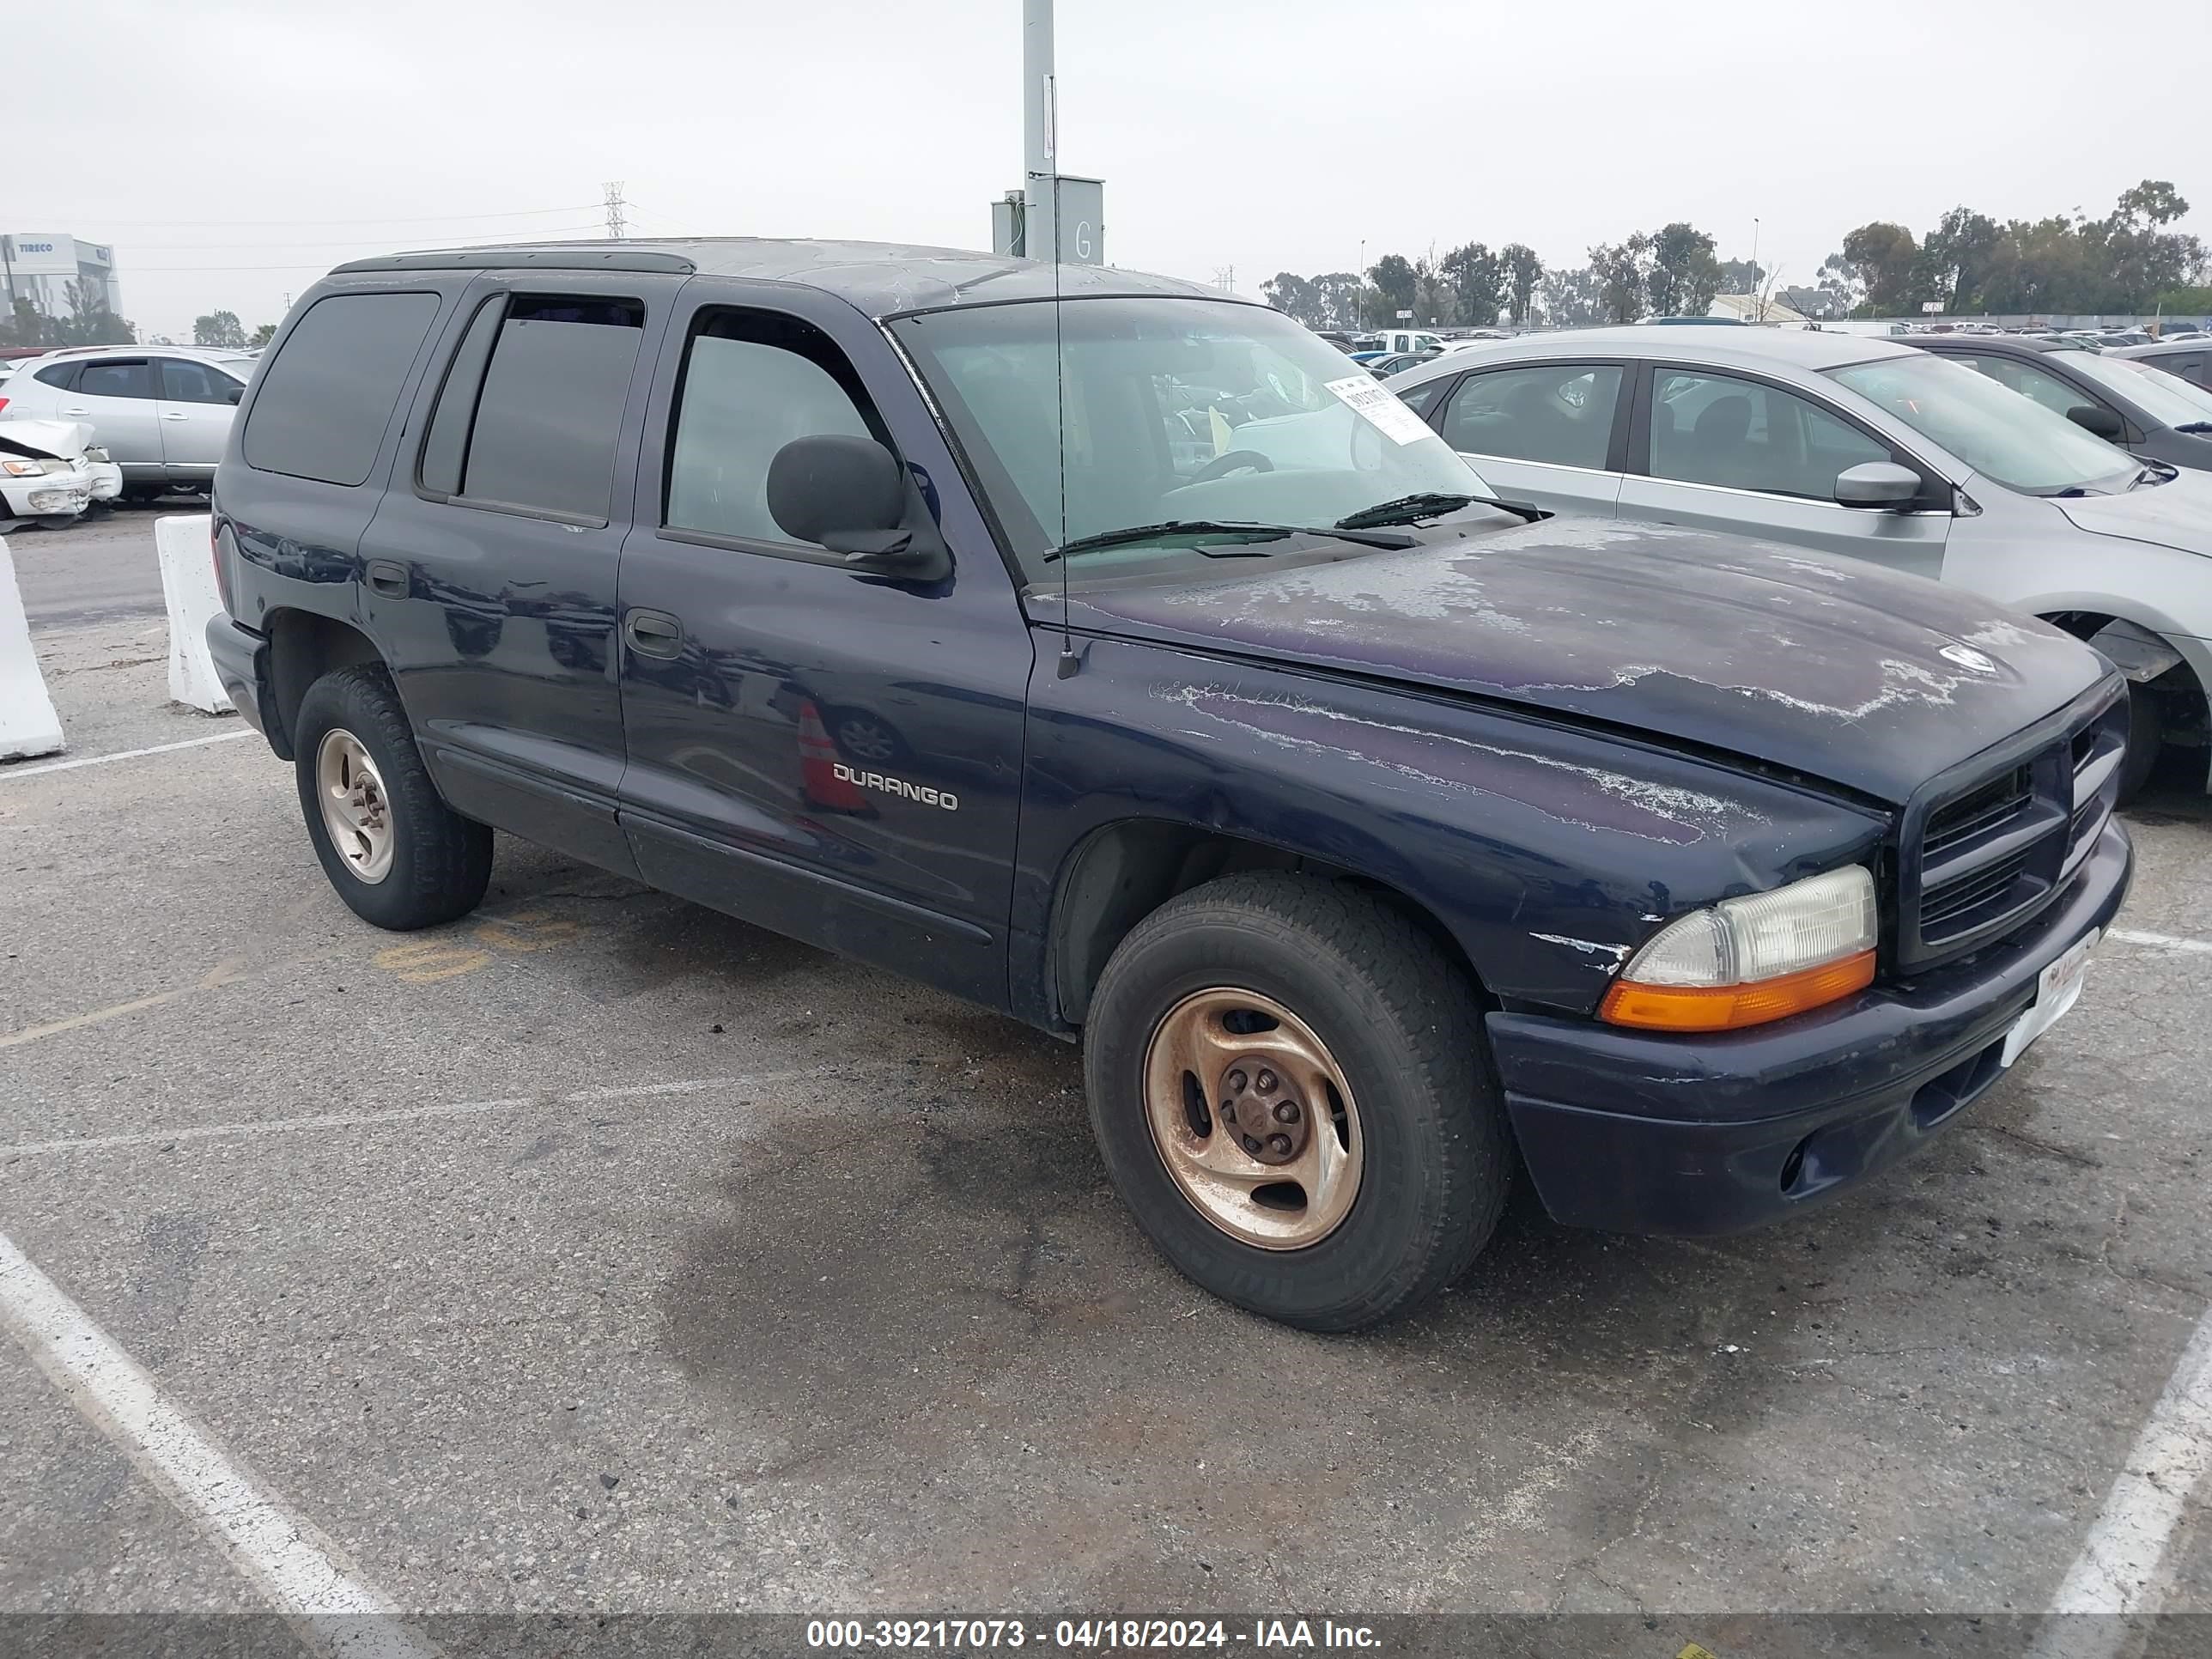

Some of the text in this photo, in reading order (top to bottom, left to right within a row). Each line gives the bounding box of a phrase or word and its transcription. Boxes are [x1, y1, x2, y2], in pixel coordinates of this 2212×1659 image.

[19, 244, 53, 252] TIRECO
[1076, 221, 1091, 258] G
[833, 763, 958, 811] DURANGO
